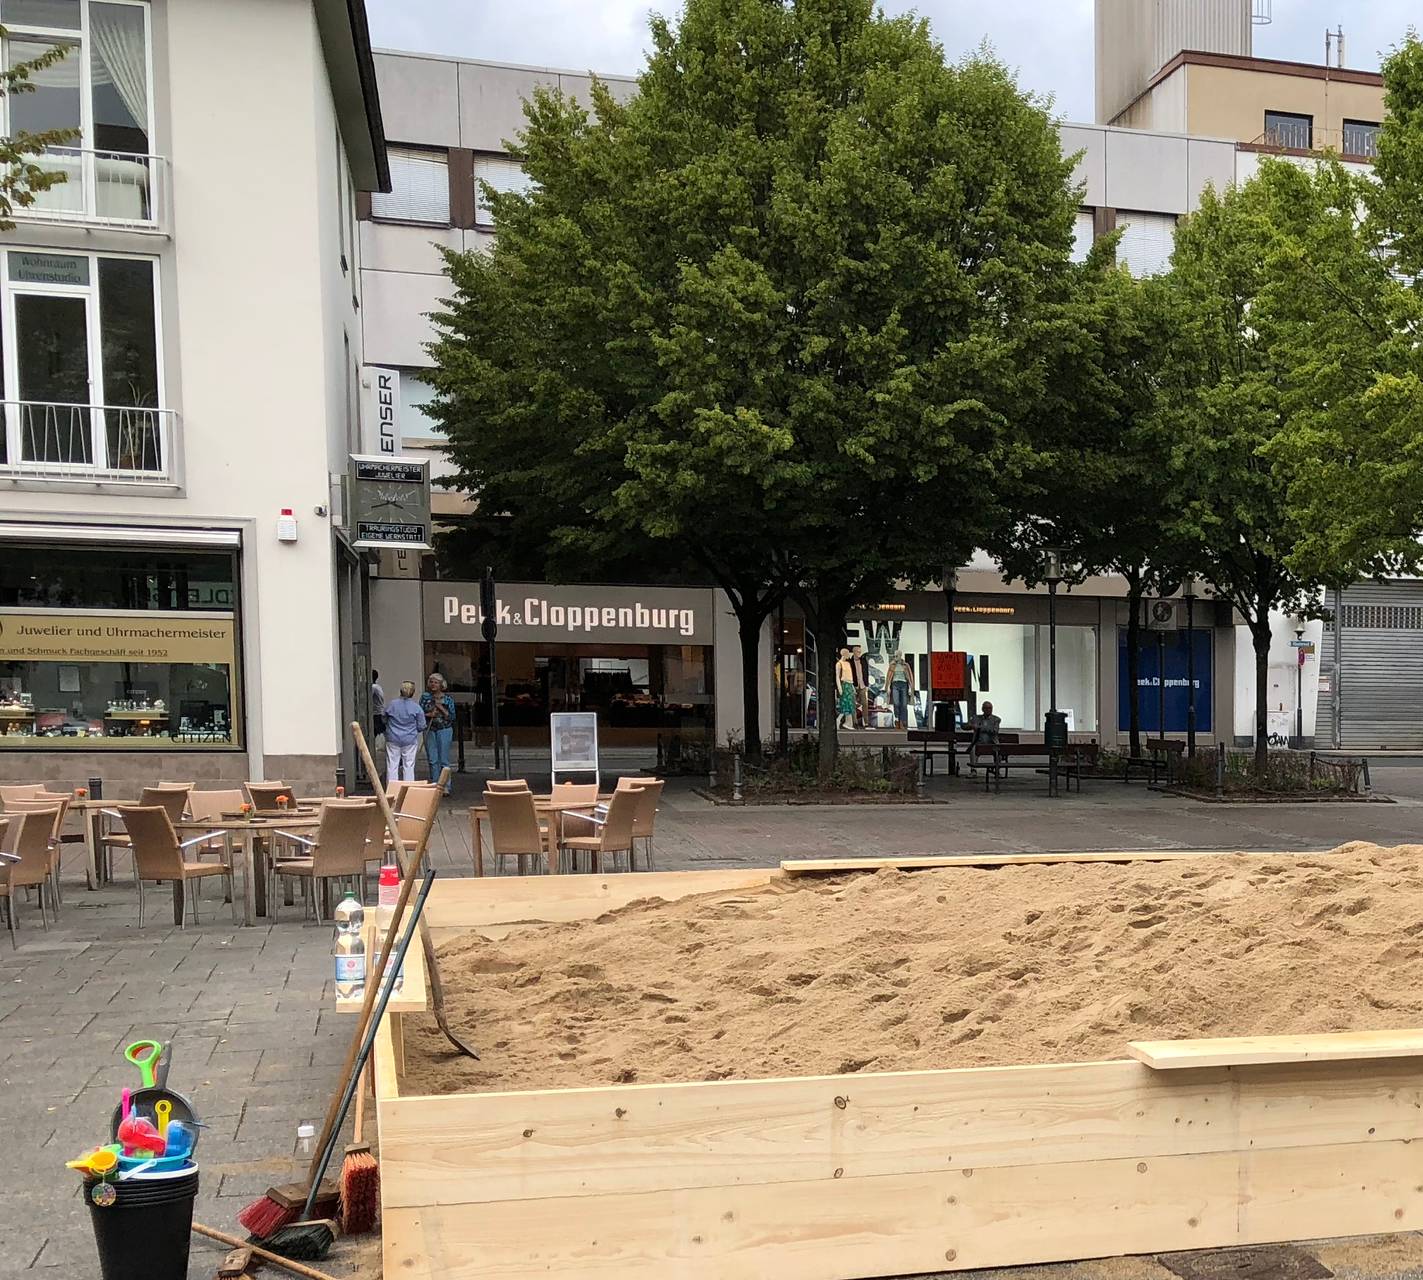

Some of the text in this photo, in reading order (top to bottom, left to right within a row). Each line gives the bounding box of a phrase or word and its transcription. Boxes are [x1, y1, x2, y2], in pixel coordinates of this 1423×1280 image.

[378, 374, 394, 457] ENSER
[17, 625, 226, 639] Juwelier und Uhrmachermeister
[8, 647, 25, 655] und
[27, 647, 67, 655] Schmuck
[129, 649, 144, 657] seit
[147, 649, 168, 657] 1952
[171, 733, 232, 744] CITIZEN
